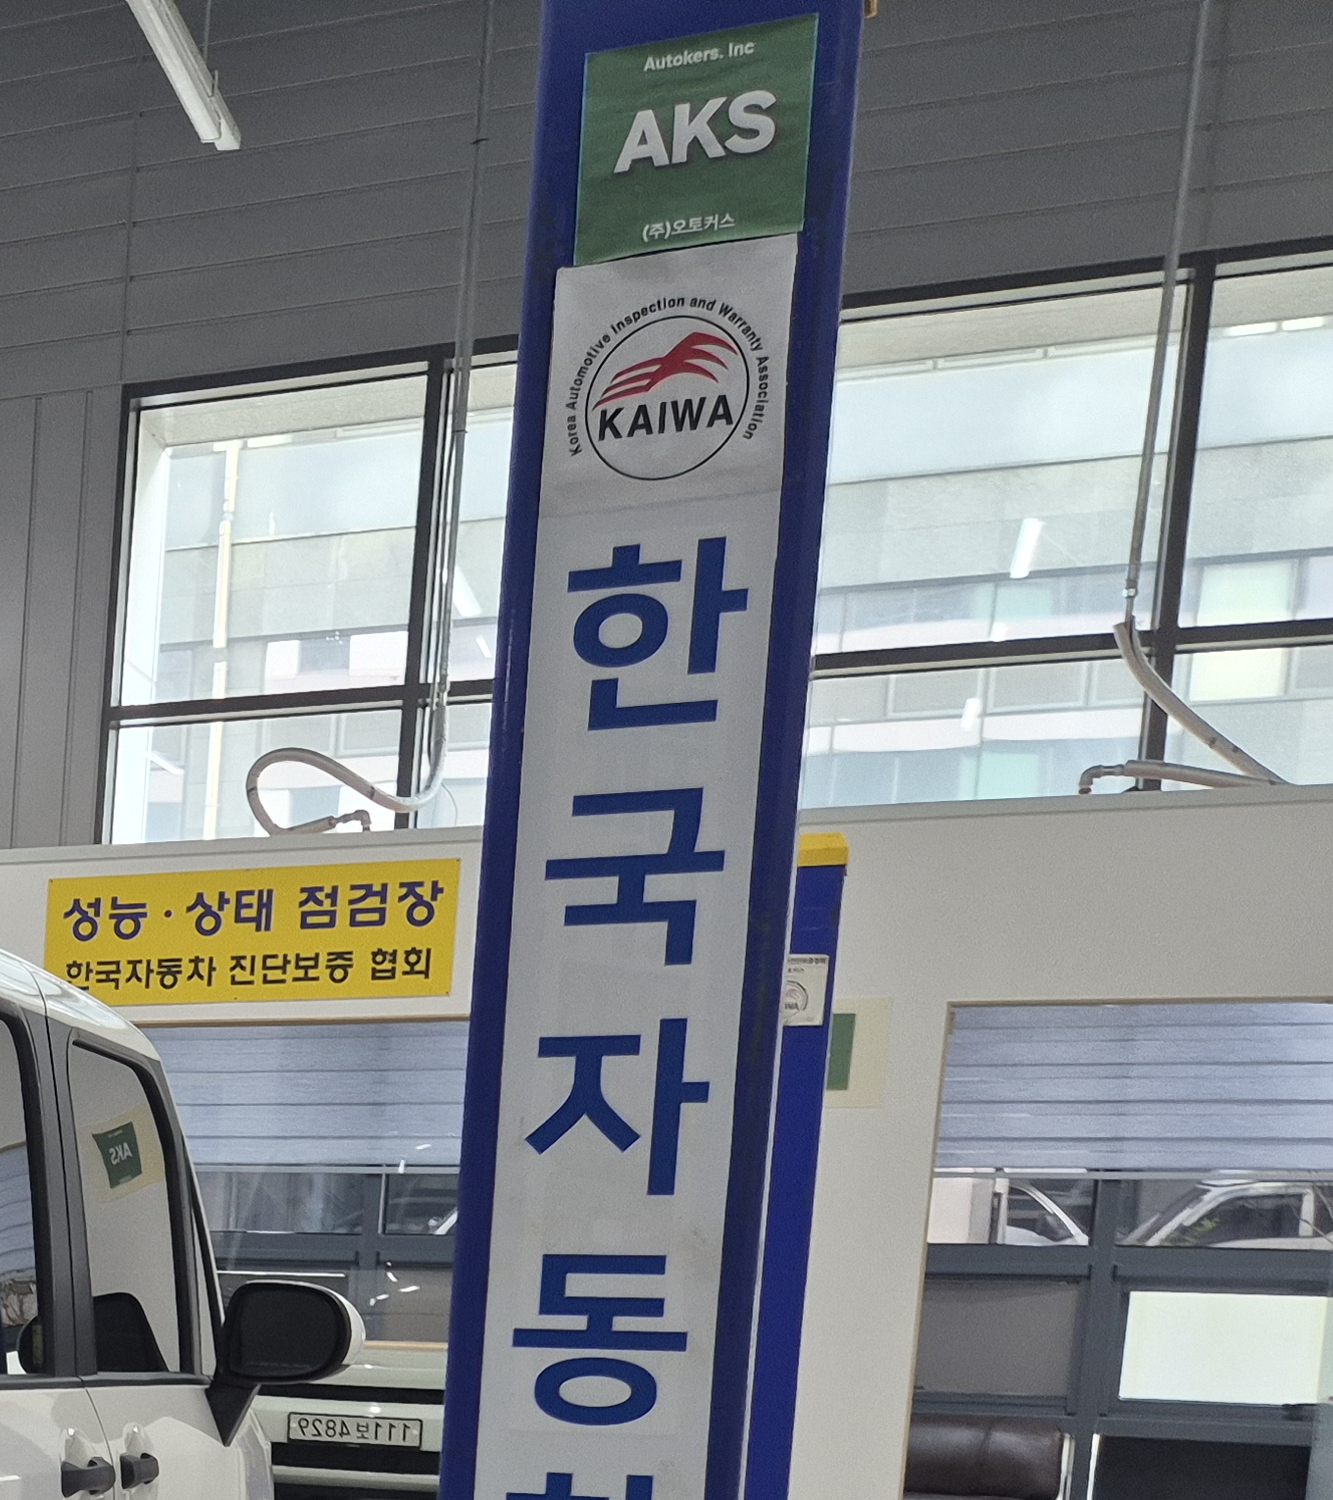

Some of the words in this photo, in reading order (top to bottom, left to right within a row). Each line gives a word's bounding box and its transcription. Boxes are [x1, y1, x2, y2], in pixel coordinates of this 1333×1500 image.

[728, 41, 755, 58] Inc
[613, 89, 778, 174] AKS
[641, 212, 736, 243] (주)오토커스
[610, 296, 686, 335] Inspection
[689, 297, 717, 312] and
[717, 302, 764, 352] Warranty
[565, 333, 611, 411] Automotive
[597, 394, 734, 442] KAIWA
[742, 355, 770, 440] Association
[566, 415, 583, 457] Korea
[297, 879, 444, 930] 점검장
[65, 954, 217, 991] 한국자동차
[229, 949, 354, 987] 진단보증
[370, 946, 433, 981] 협회
